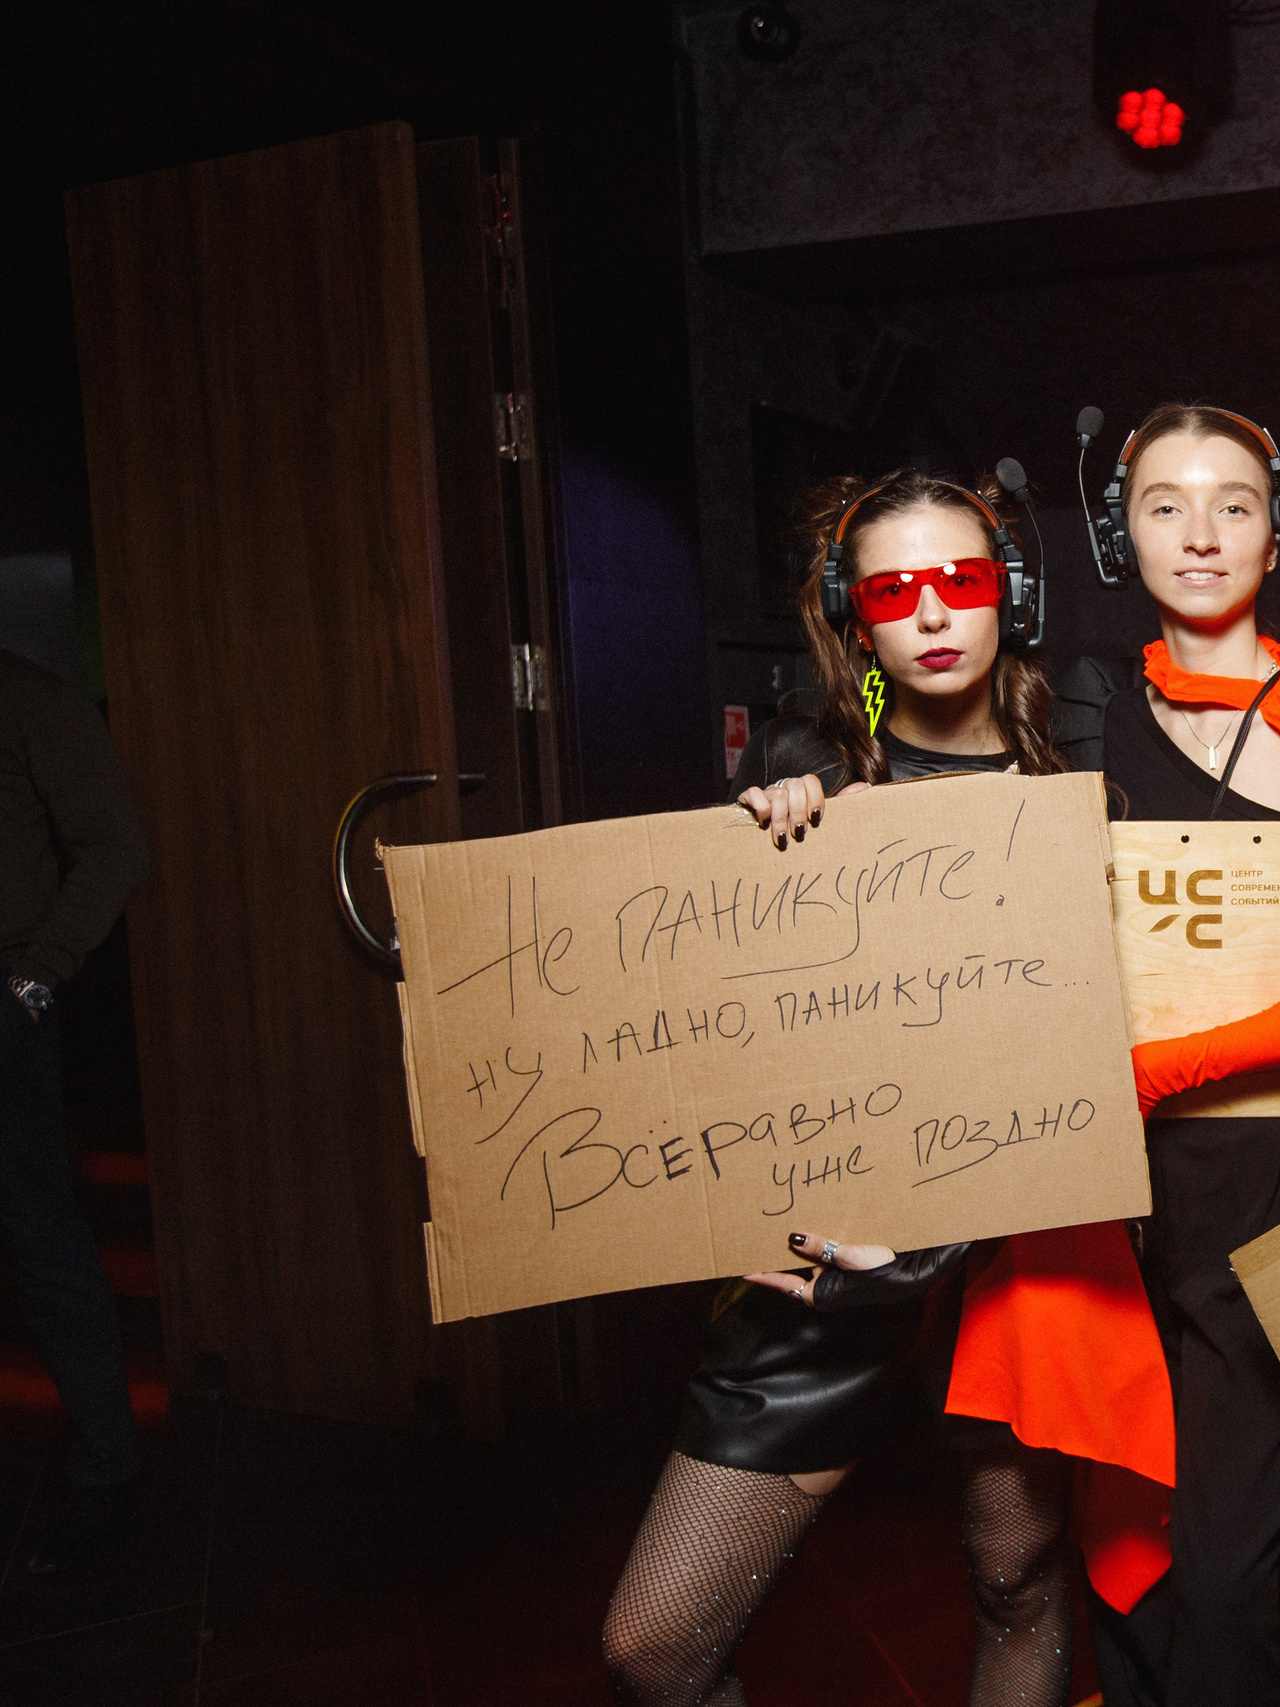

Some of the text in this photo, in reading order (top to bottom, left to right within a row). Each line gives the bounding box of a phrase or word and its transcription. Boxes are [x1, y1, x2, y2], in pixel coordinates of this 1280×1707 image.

[1230, 870, 1264, 879] ЦЕНТР
[1230, 896, 1280, 906] СОБЫТИЙ
[437, 875, 580, 1019] Не
